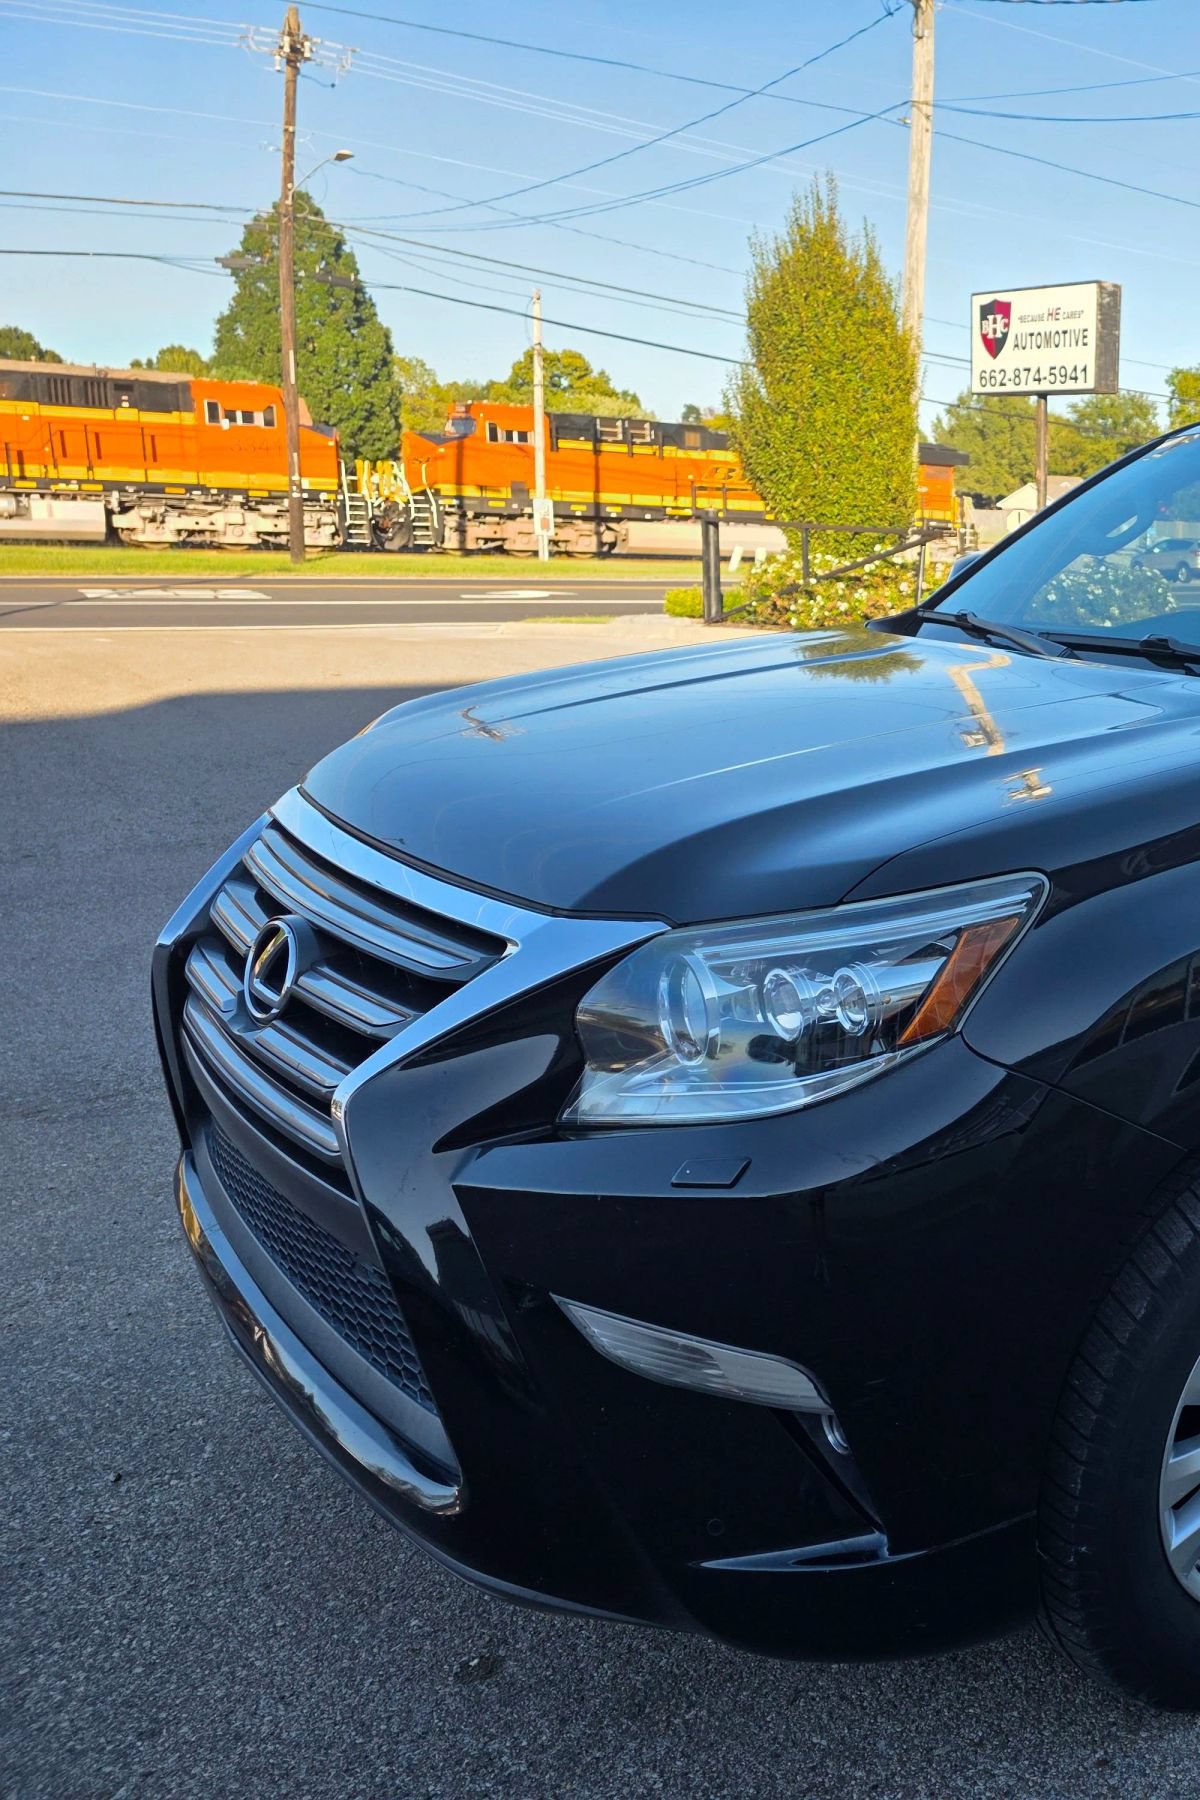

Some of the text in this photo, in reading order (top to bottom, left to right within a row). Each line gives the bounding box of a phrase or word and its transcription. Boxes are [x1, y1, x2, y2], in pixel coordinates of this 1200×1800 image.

[1047, 307, 1061, 321] HE
[1013, 328, 1088, 351] AUTOMOTIVE
[979, 364, 1088, 388] 662-874-5941
